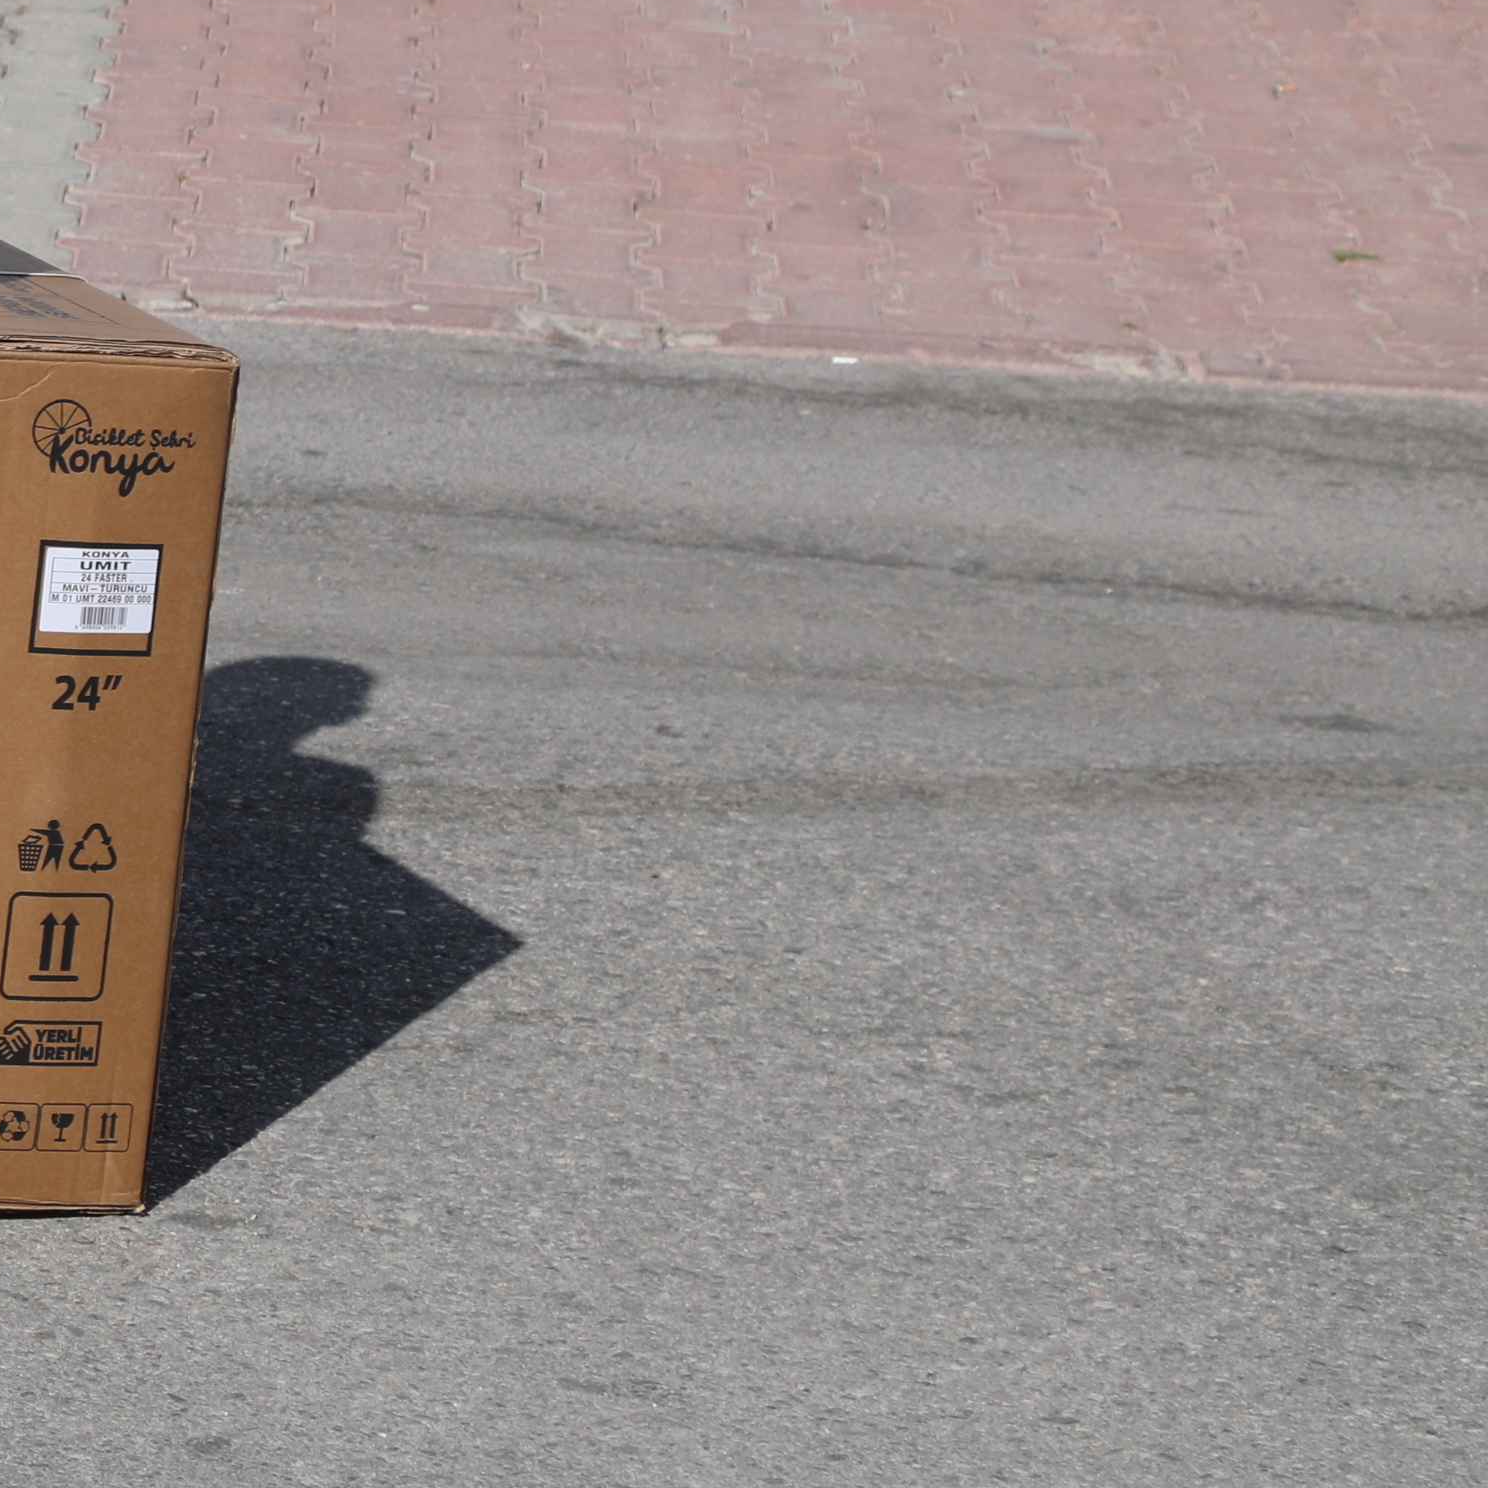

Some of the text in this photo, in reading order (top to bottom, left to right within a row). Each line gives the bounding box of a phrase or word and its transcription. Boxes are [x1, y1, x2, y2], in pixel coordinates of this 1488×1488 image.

[75, 427, 197, 450] Bisiklet Şehri
[49, 434, 176, 498] Konya
[80, 561, 132, 571] UMIT
[81, 573, 128, 583] 24 FASTER
[62, 584, 89, 593] MAVI
[100, 584, 148, 593] TURUNCU
[51, 594, 59, 602] M
[76, 595, 95, 603] UMT
[35, 1026, 82, 1043] YERLİ
[33, 1043, 94, 1061] ÜRETİM
